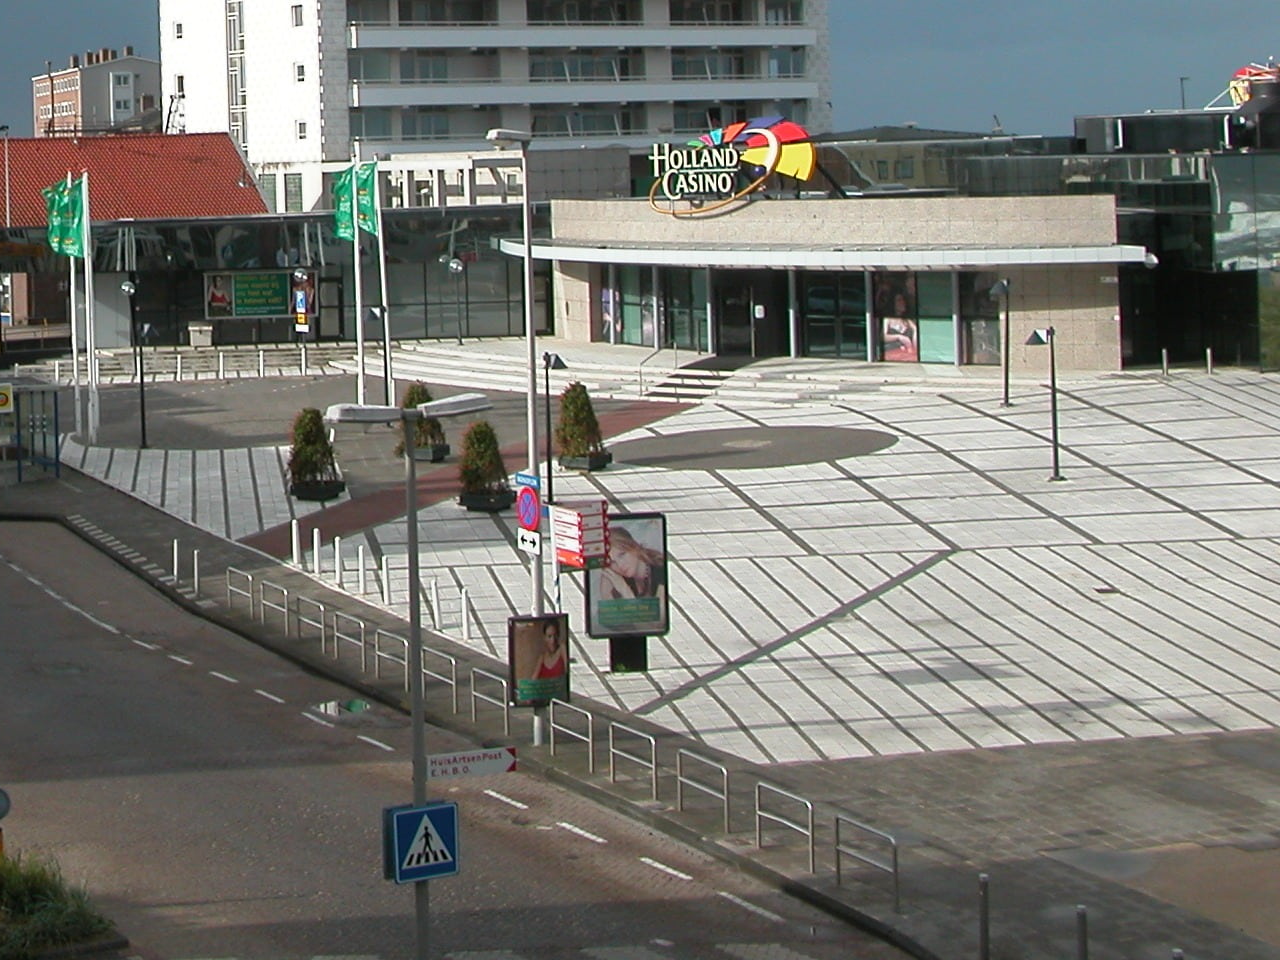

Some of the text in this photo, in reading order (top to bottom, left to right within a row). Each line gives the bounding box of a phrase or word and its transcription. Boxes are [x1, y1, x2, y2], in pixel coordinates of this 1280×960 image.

[649, 142, 740, 177] HOLLAND
[662, 169, 733, 200] CASINO
[430, 751, 502, 768] HuisArtsenPost
